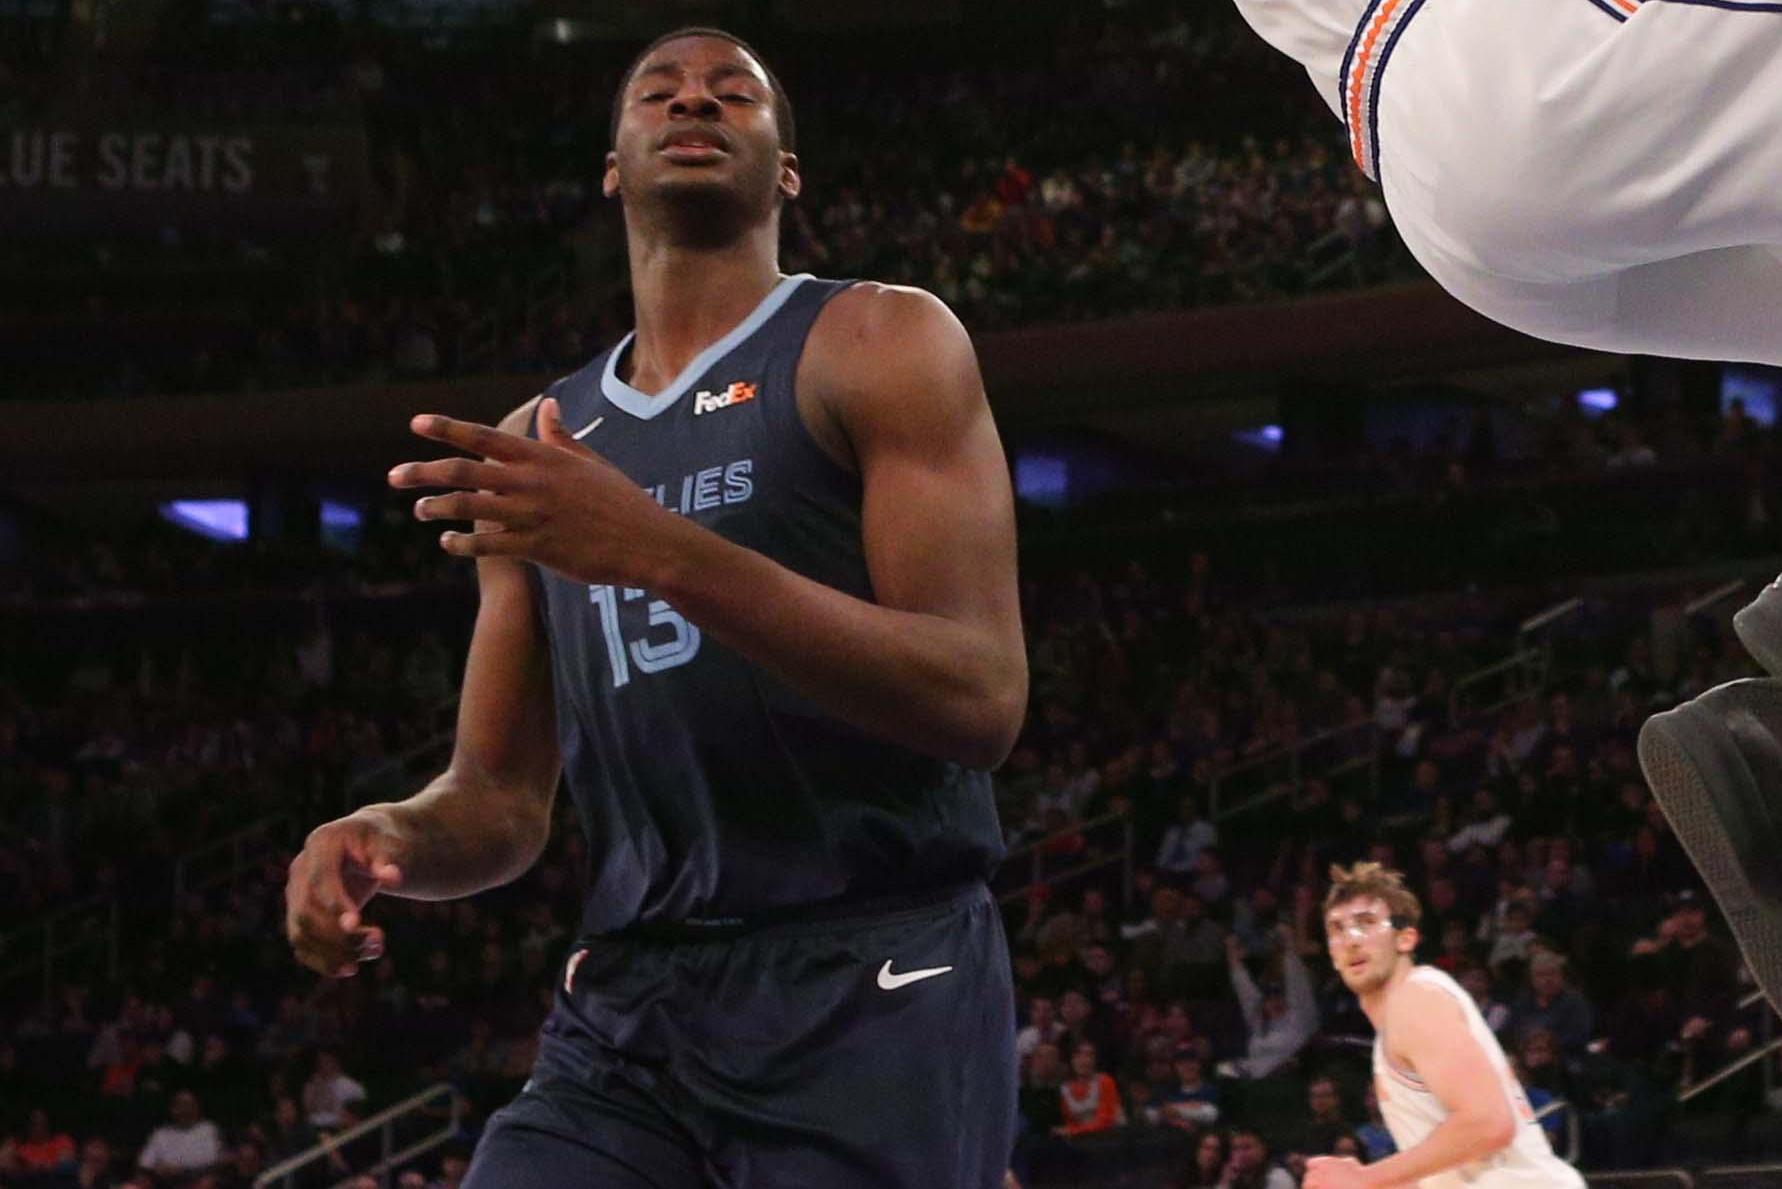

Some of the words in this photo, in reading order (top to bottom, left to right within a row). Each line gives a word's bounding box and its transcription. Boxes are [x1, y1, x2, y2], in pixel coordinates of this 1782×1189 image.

[97, 132, 255, 192] SEATS
[694, 381, 758, 415] FedEx
[589, 584, 701, 689] 13
